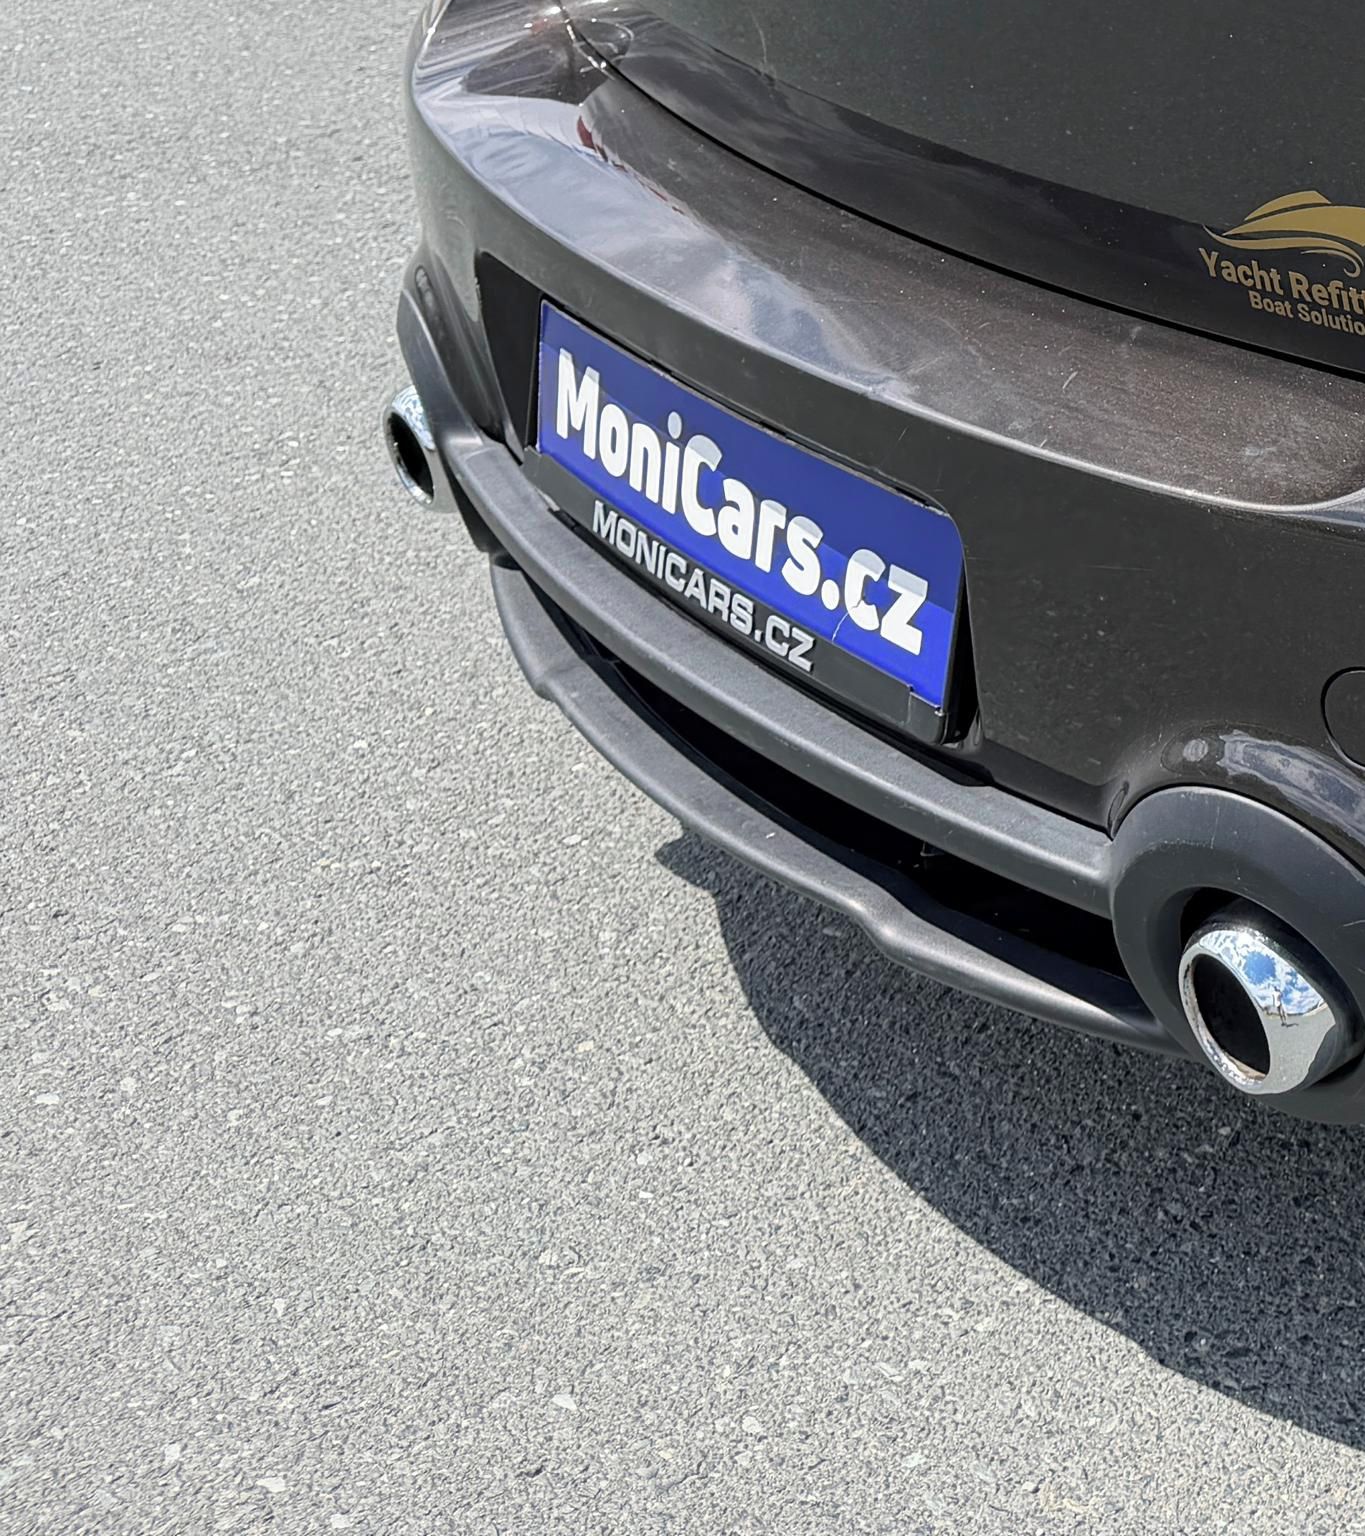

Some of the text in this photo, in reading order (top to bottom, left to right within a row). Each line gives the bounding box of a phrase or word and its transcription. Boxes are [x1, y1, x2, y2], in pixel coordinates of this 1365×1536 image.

[1198, 247, 1285, 296] Yacht
[1249, 291, 1294, 319] Boat
[556, 347, 929, 656] MoniCars.cz
[590, 500, 816, 673] MONICARS.CZ
